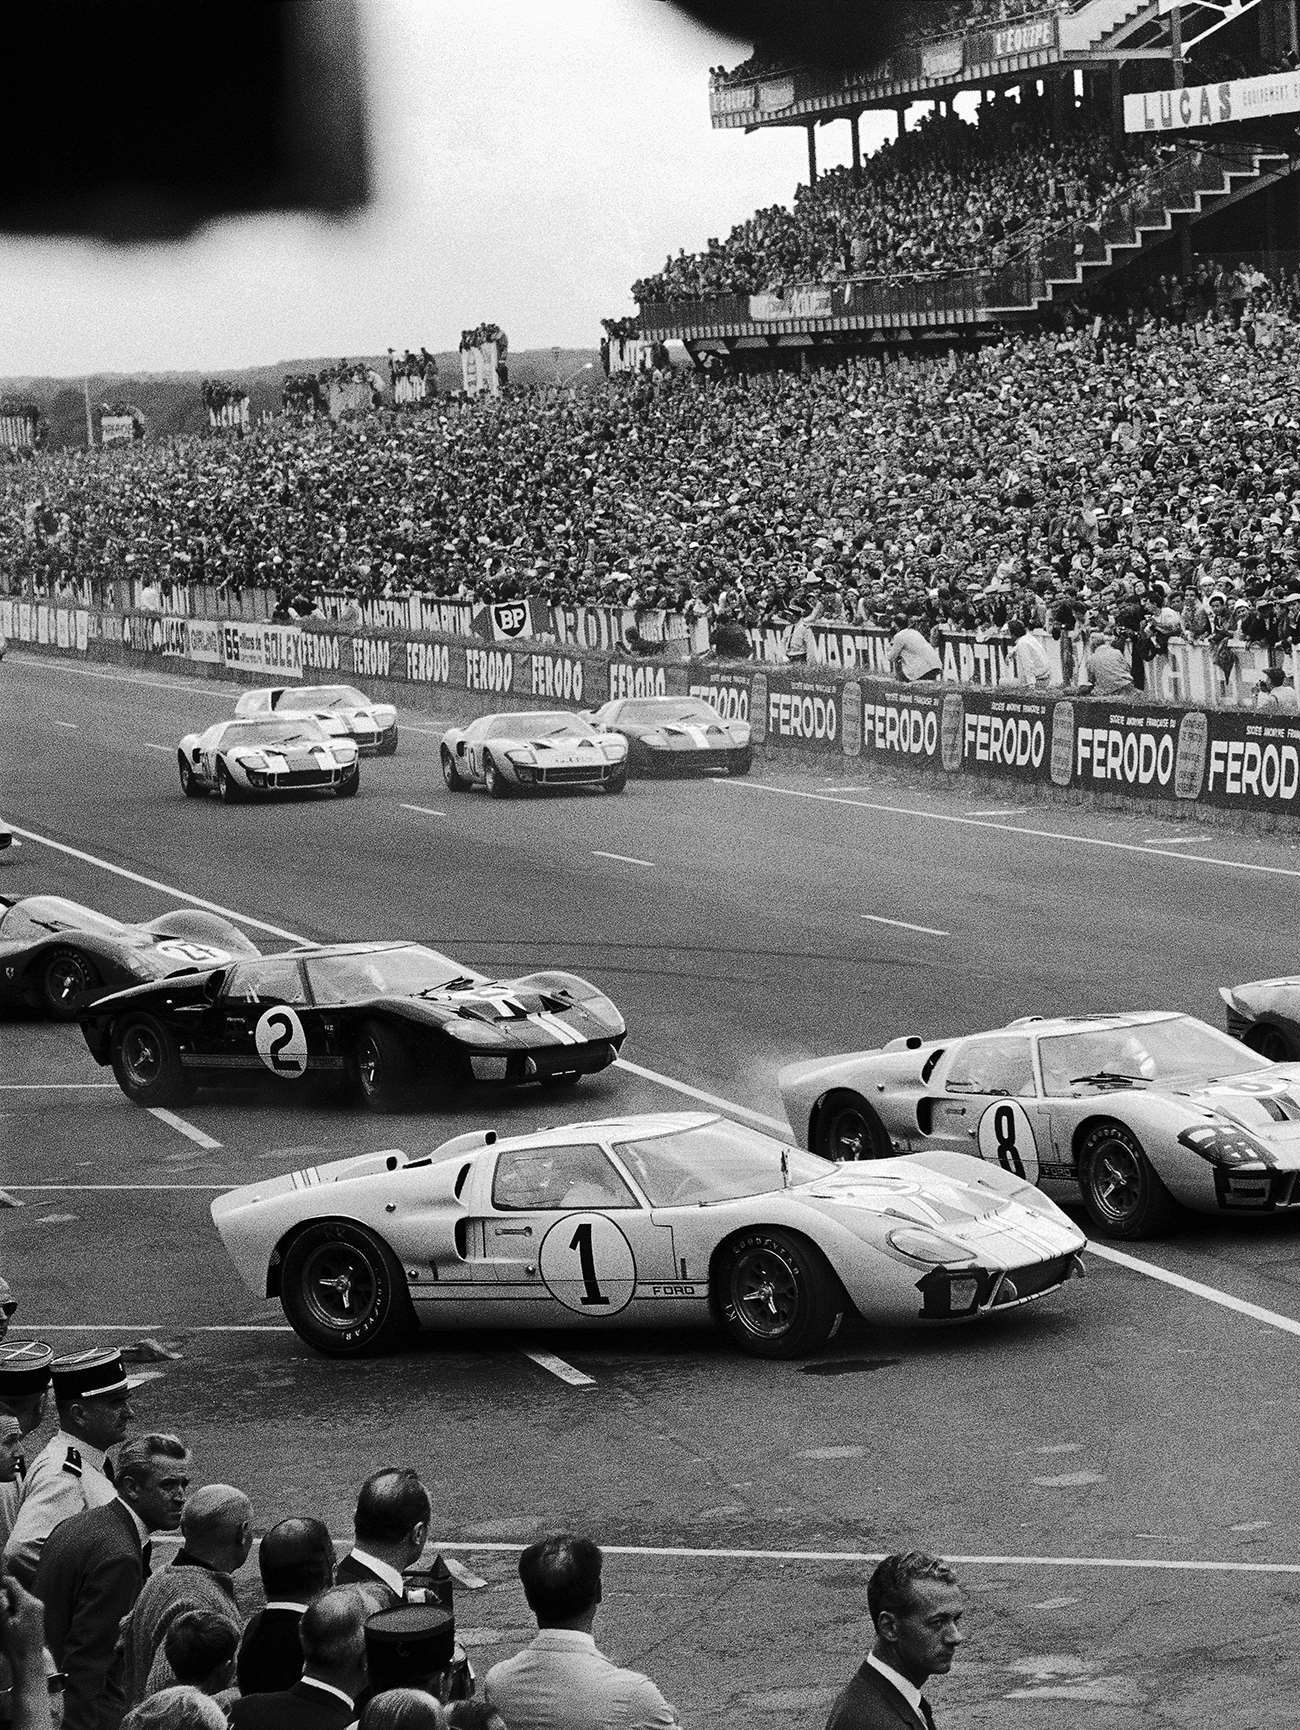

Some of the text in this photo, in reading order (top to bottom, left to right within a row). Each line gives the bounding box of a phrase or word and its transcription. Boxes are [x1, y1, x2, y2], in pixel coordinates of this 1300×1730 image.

[1144, 84, 1231, 130] LUCAS
[499, 609, 524, 629] BP
[407, 643, 448, 682] FERODO
[467, 650, 511, 692] FERODO
[532, 655, 582, 700] FERODO
[769, 692, 837, 741] FERODO
[864, 704, 936, 756] FERODO
[965, 713, 1045, 768] FERODO
[1077, 728, 1173, 785] FERODO
[266, 1012, 303, 1071] 2
[994, 1105, 1027, 1181] 8
[1043, 1165, 1071, 1178] FORD
[569, 1222, 611, 1306] 1
[653, 1285, 695, 1297] FORD
